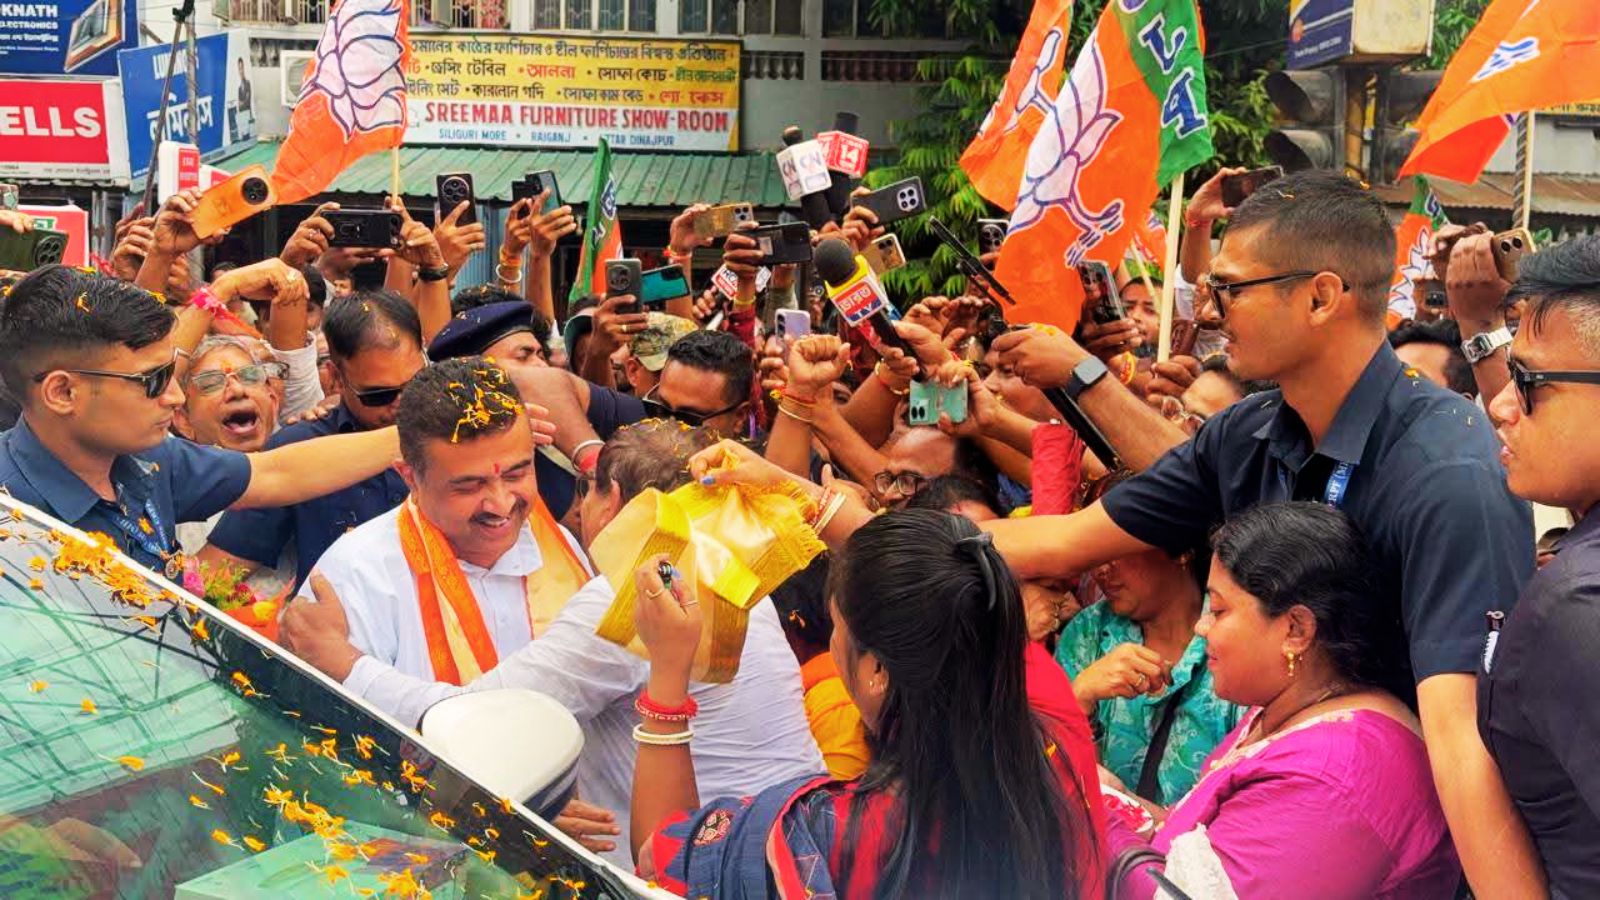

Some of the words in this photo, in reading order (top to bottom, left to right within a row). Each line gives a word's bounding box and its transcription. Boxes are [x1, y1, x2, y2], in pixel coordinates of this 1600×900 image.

[0, 4, 58, 18] KNATH
[467, 59, 506, 76] টেবিল
[527, 63, 576, 79] আলনা
[522, 82, 545, 99] গদি
[0, 106, 101, 138] ELLS
[424, 101, 513, 124] SREEMAA
[520, 105, 618, 128] FURNITURE
[622, 109, 729, 132] SHOW-ROOM
[439, 128, 478, 140] SILIGURI
[482, 130, 507, 141] MORE
[531, 131, 571, 143] RAIGANJ
[603, 133, 626, 145] TTAR
[630, 134, 675, 146] DINAJPUR
